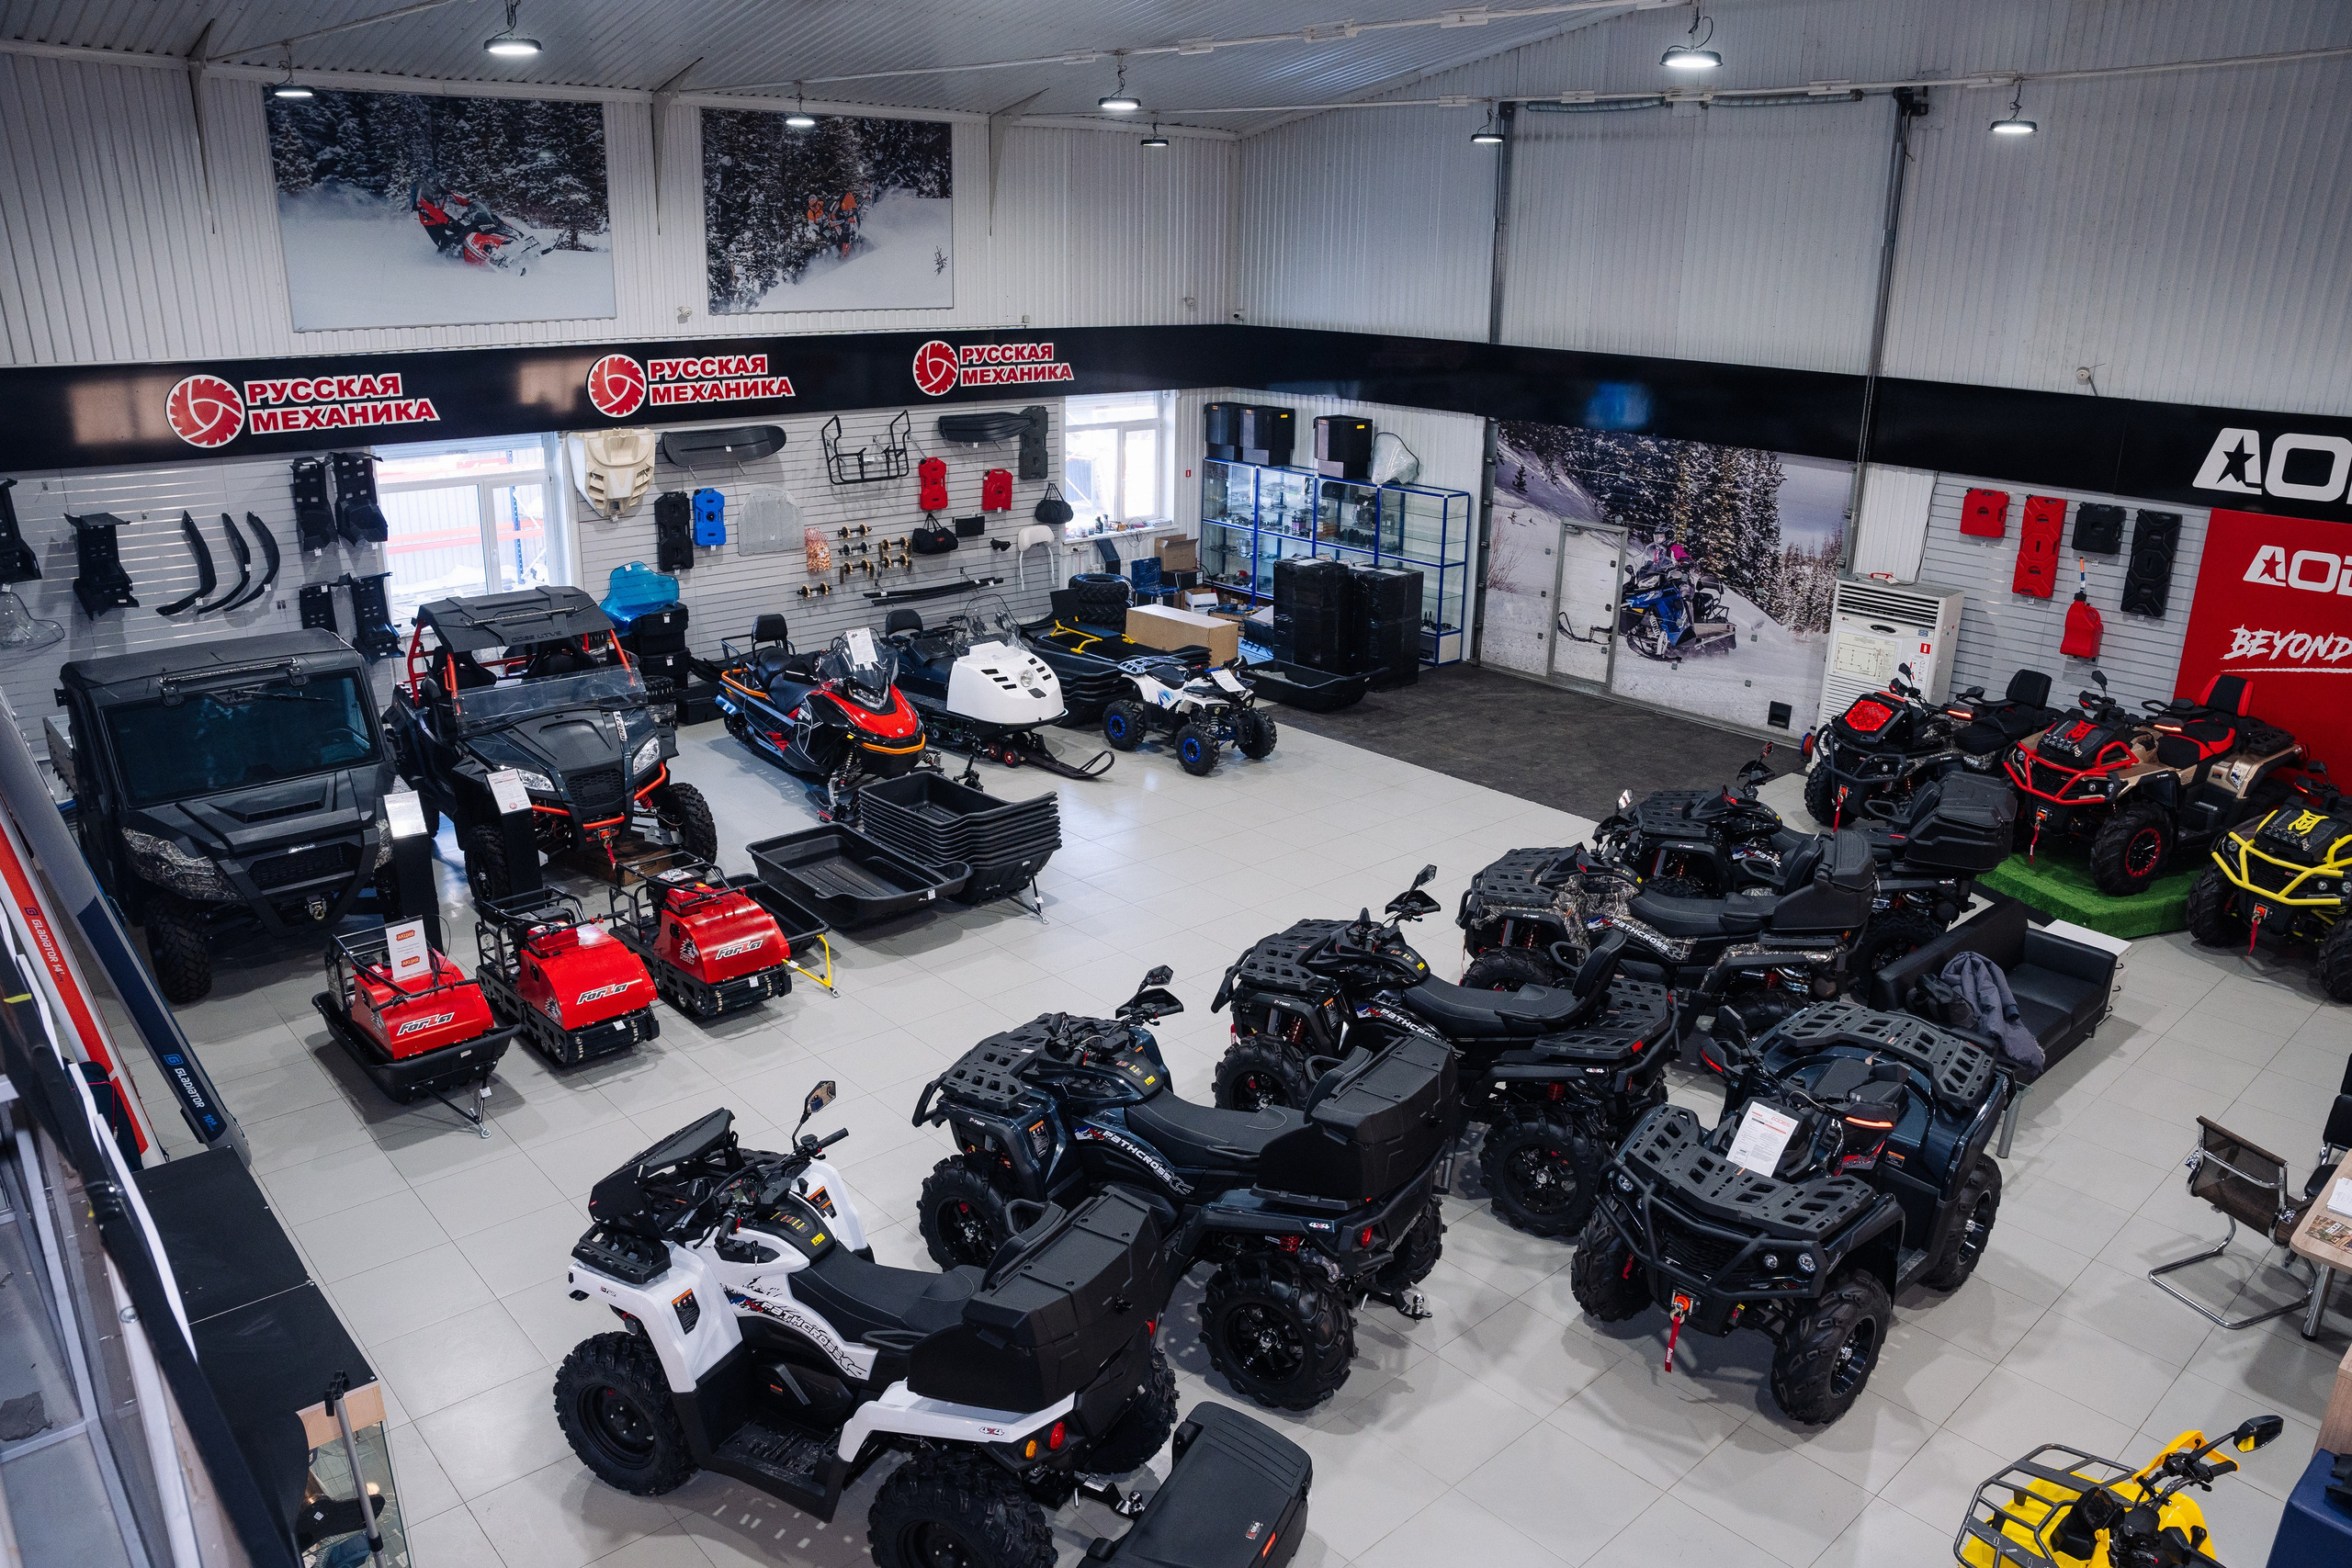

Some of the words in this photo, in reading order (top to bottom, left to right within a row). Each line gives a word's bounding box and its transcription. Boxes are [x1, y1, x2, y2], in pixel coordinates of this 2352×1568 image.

[648, 354, 768, 382] РУССКАЯ
[960, 343, 1055, 365] РУССКАЯ
[243, 373, 402, 406] РУССКАЯ
[960, 363, 1074, 387] МЕХАНИКА
[649, 377, 796, 406] МЕХАНИКА
[248, 398, 440, 434] МЕХАНИКА
[2192, 427, 2352, 504] AO
[2220, 624, 2352, 664] BEYOND
